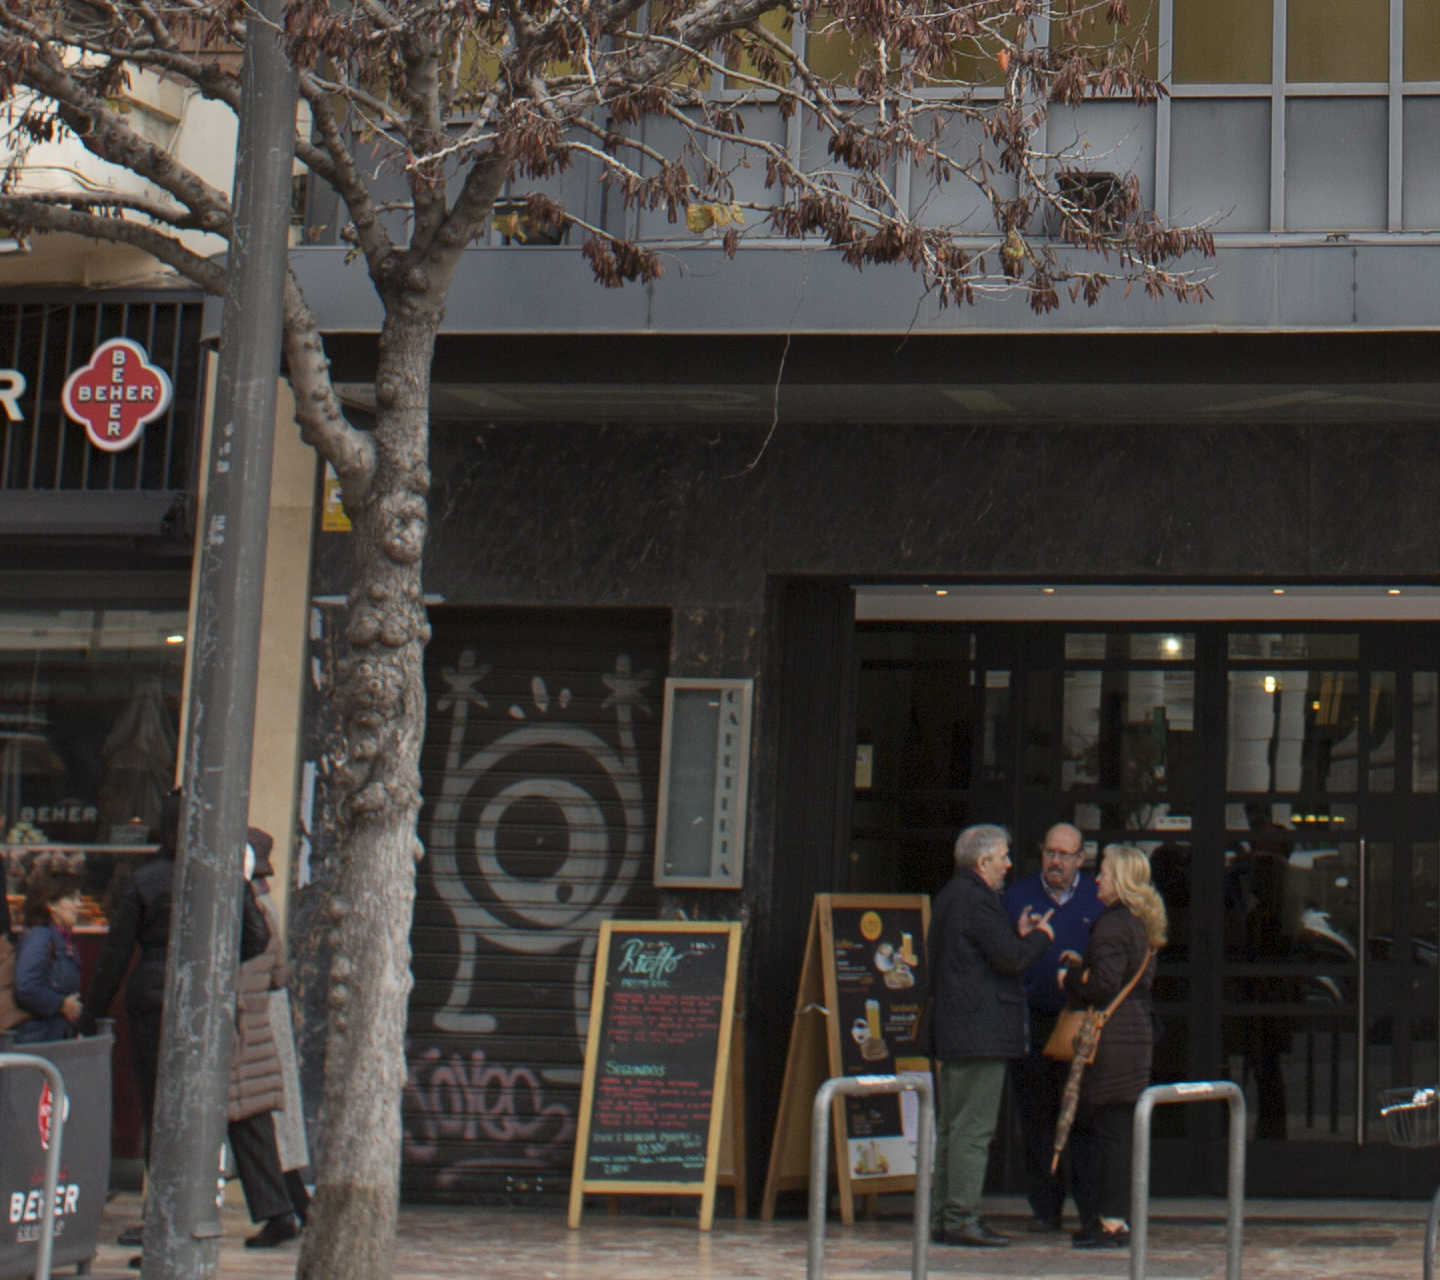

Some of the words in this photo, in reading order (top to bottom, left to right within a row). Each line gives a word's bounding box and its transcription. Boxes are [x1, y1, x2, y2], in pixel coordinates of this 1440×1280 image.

[78, 386, 155, 403] BEHER
[106, 349, 126, 437] BEHER
[9, 1184, 80, 1224] BEER
